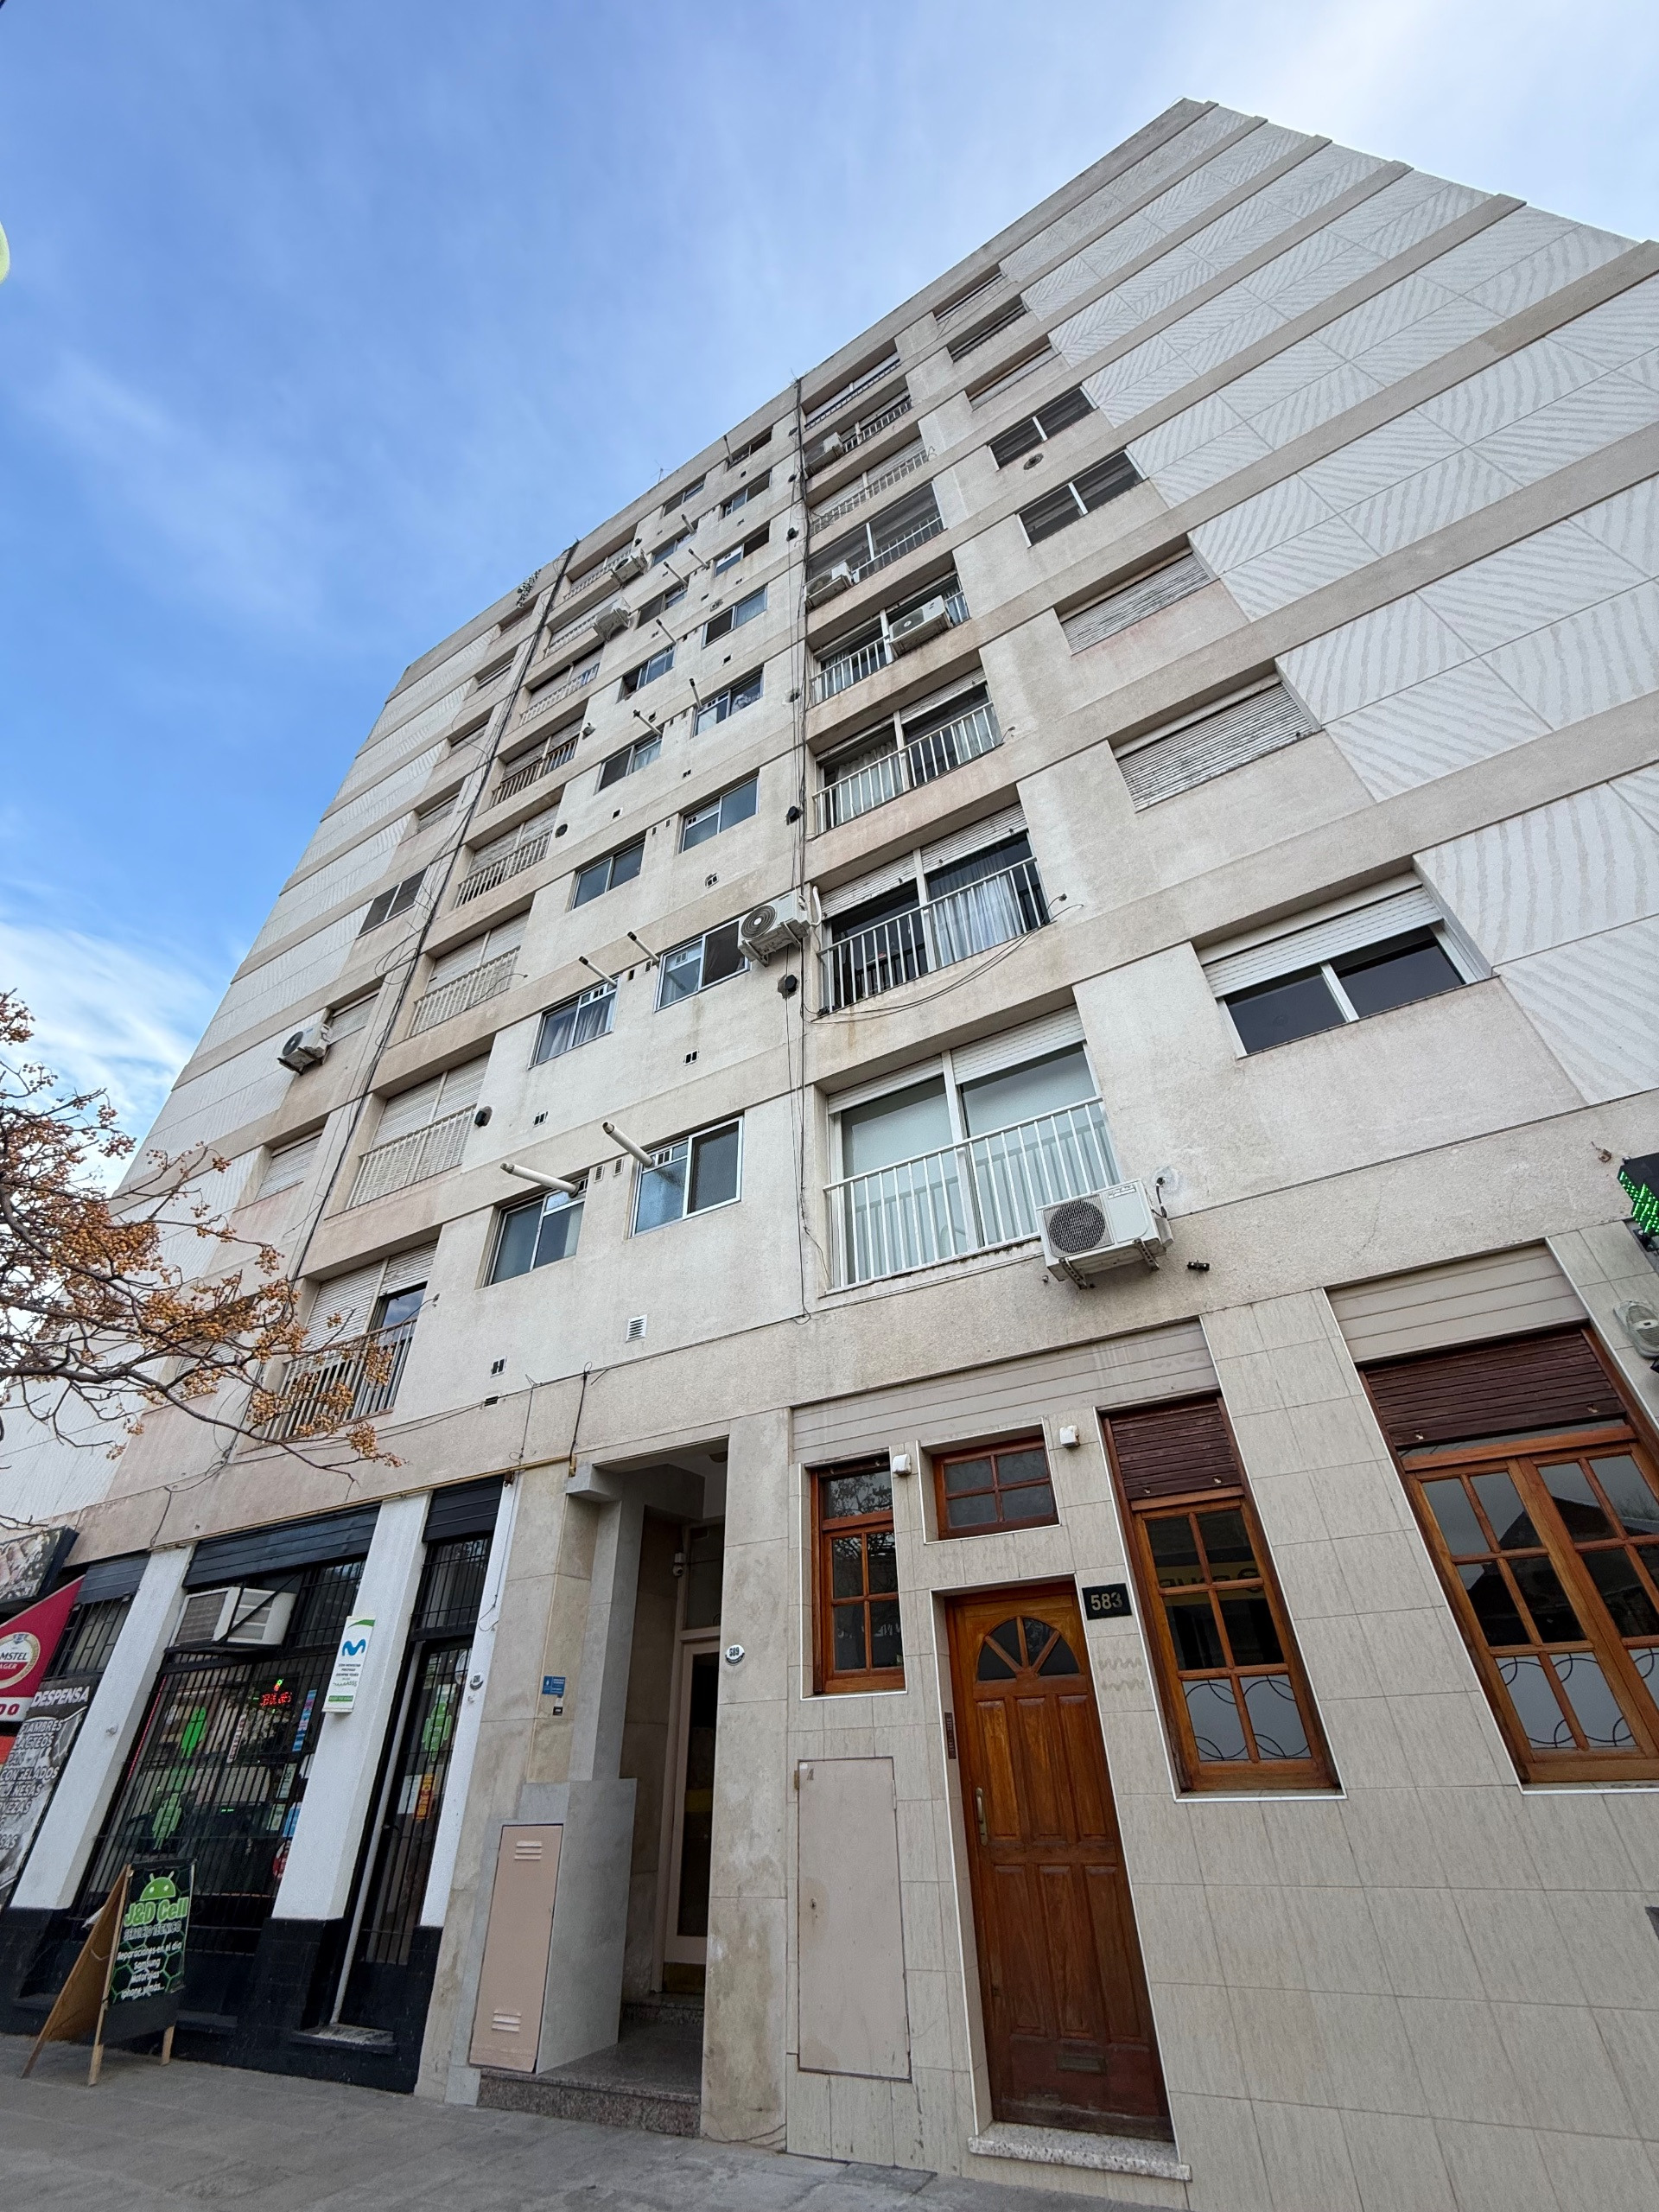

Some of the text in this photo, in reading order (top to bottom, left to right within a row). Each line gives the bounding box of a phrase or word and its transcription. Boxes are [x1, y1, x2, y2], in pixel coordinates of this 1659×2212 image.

[1090, 1592, 1123, 1611] 583
[0, 1652, 27, 1661] MSTEL
[31, 1686, 90, 1707] DESPENSA
[19, 1719, 64, 1734] FIAMBRES
[124, 1897, 188, 1927] J&D Cell
[134, 1959, 161, 1969] Samsung
